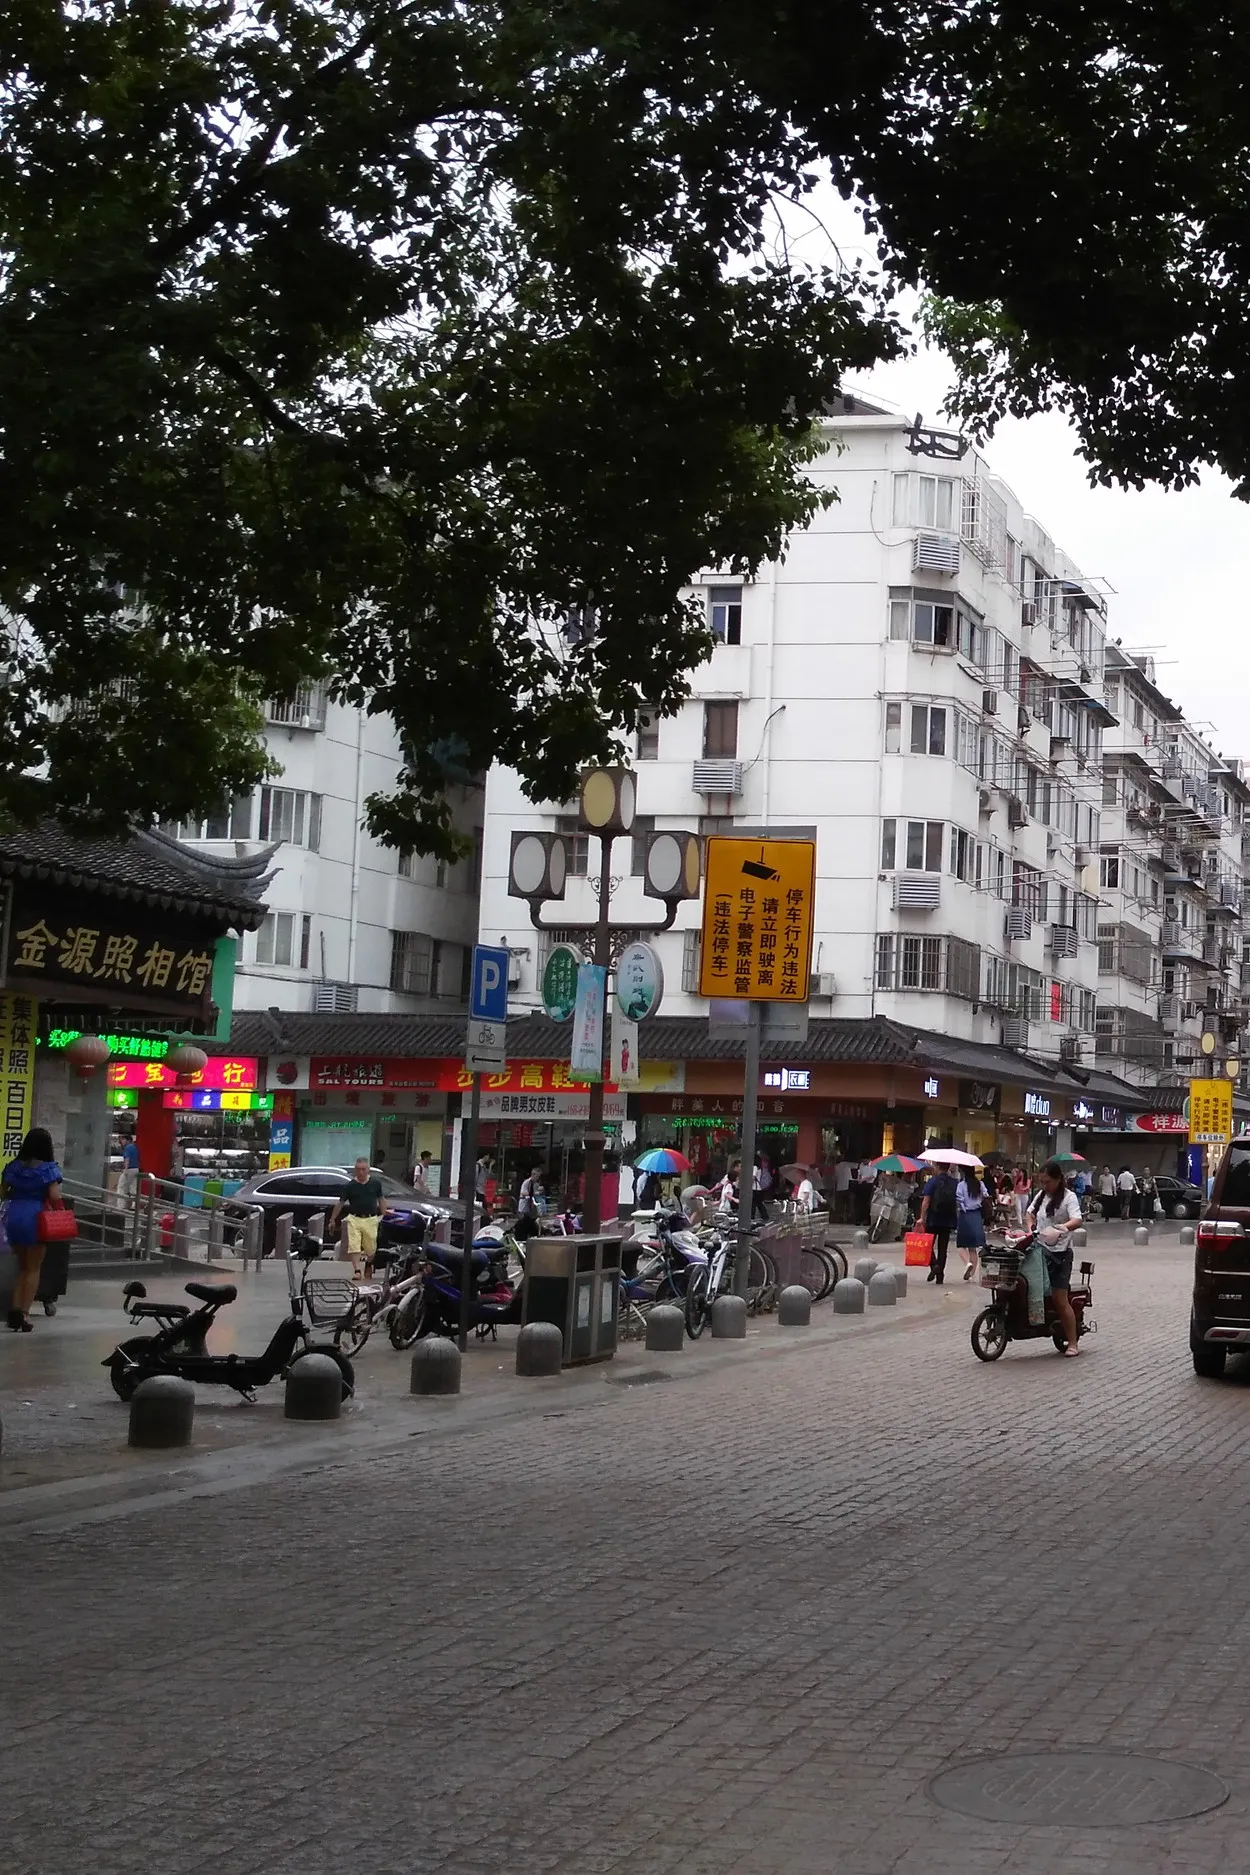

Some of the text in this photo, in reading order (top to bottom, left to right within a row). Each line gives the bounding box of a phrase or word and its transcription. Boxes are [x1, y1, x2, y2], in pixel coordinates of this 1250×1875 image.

[14, 918, 214, 995] 金源照相馆
[734, 887, 756, 993] 电子警察监管
[757, 897, 780, 986] 请立即驶离
[780, 888, 804, 995] 停车行为违法
[479, 959, 500, 1007] P
[3, 996, 33, 1157] 集体照 百日照
[108, 1062, 247, 1085] 七宝行
[344, 1078, 384, 1086] TOURS
[500, 1095, 556, 1114] 品牌男女皮鞋
